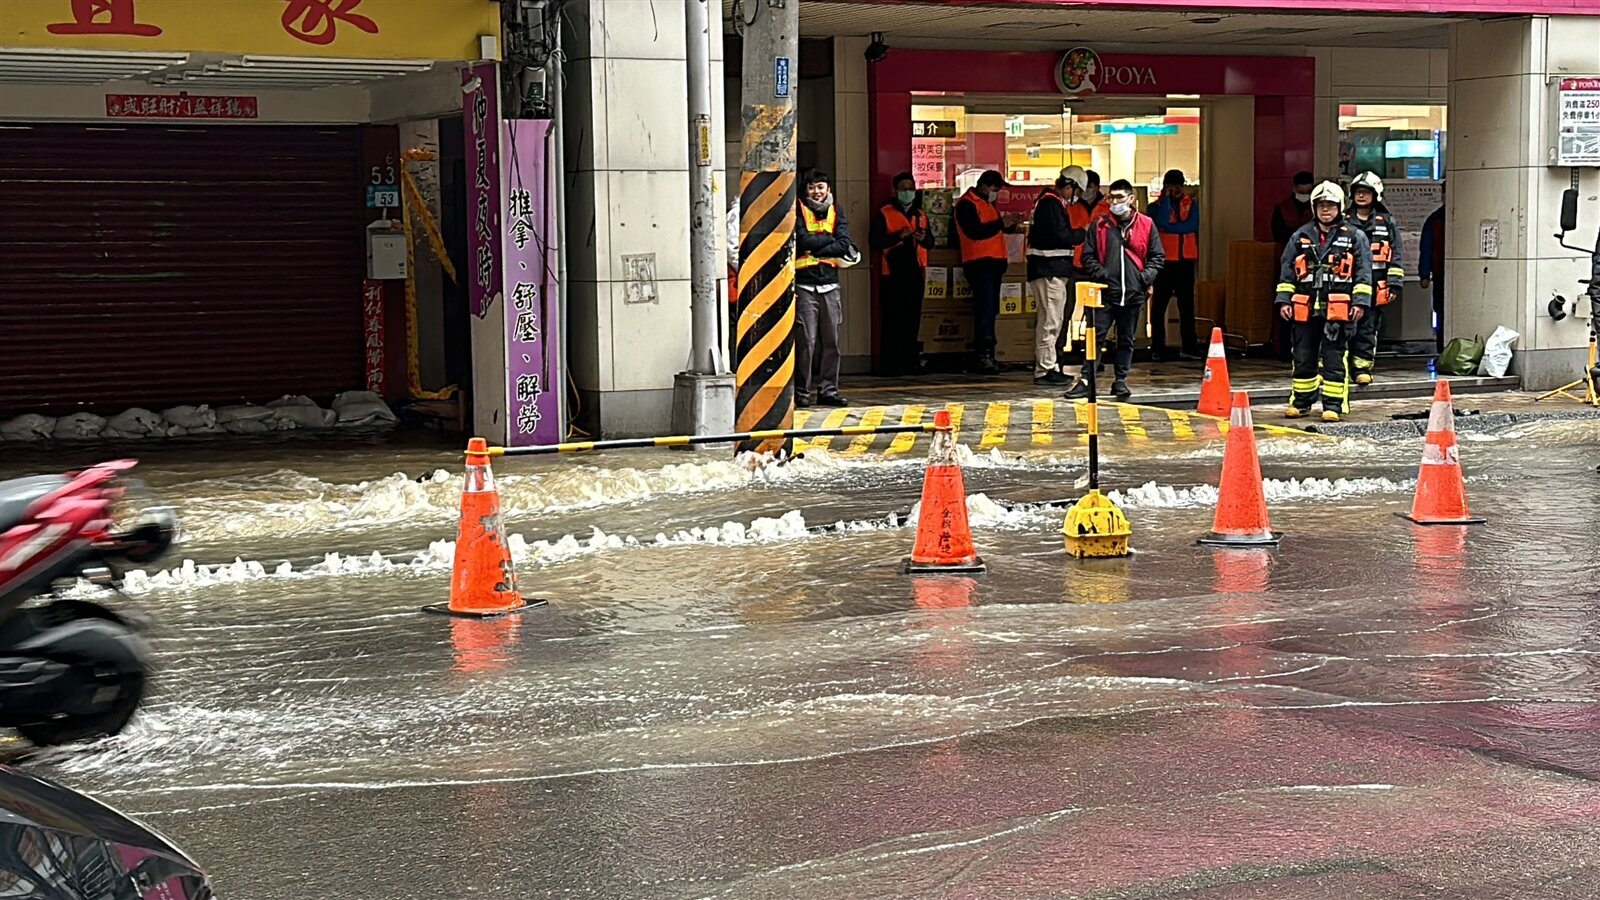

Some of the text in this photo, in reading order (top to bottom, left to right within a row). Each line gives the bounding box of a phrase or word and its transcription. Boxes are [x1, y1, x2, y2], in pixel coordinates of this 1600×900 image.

[1105, 67, 1156, 85] POYA
[371, 166, 395, 184] 53
[380, 193, 394, 205] 53
[928, 287, 944, 296] 109
[1005, 302, 1016, 312] 69
